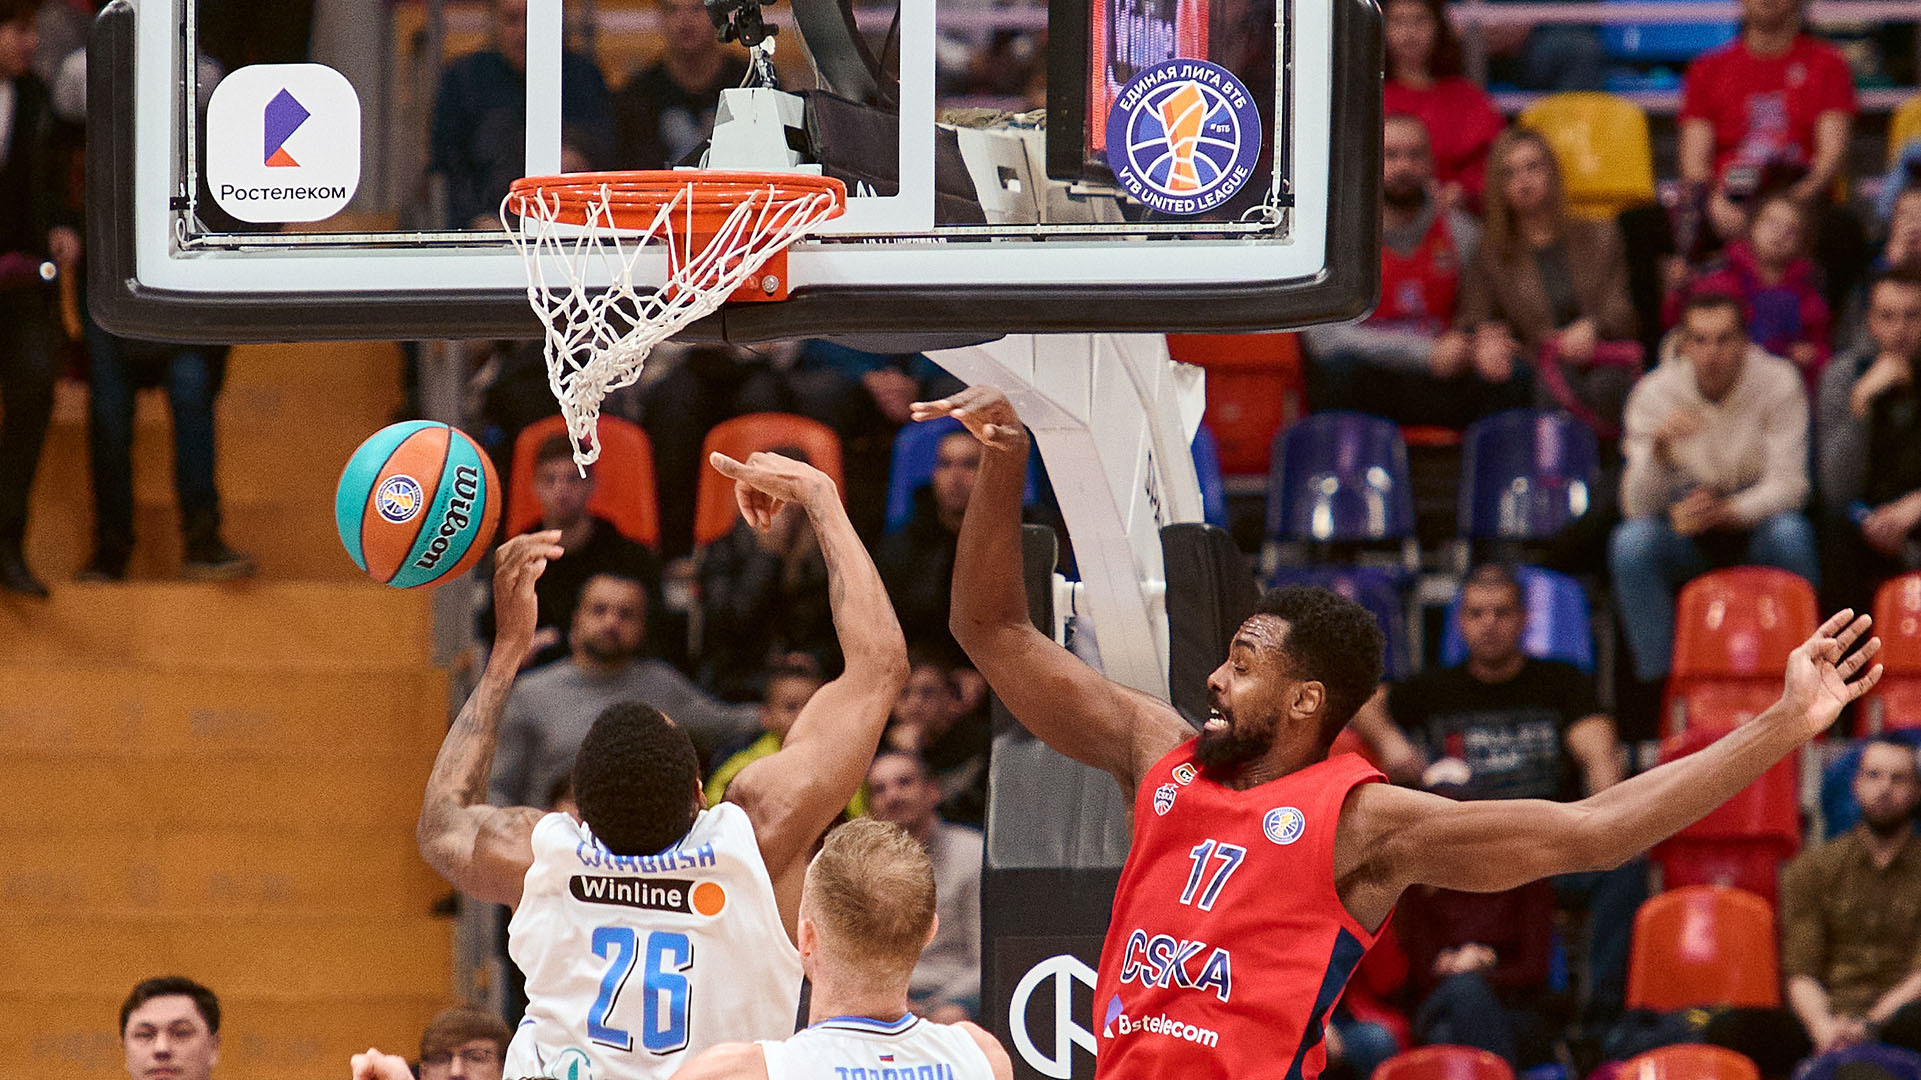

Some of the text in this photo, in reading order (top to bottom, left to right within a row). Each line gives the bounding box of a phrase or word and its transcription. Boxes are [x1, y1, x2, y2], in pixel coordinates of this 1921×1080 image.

[1119, 65, 1247, 111] ЕДИНАЯ ЛИГА ВТБ
[221, 184, 346, 200] Ростелеком
[1119, 165, 1248, 212] VTB UNITED LEAGUE
[414, 464, 479, 570] Wilson
[576, 841, 716, 873] WIMBUSH
[1179, 838, 1247, 912] 17
[580, 875, 682, 907] Winline
[1120, 928, 1232, 1003] CSKA
[587, 926, 694, 1056] 26
